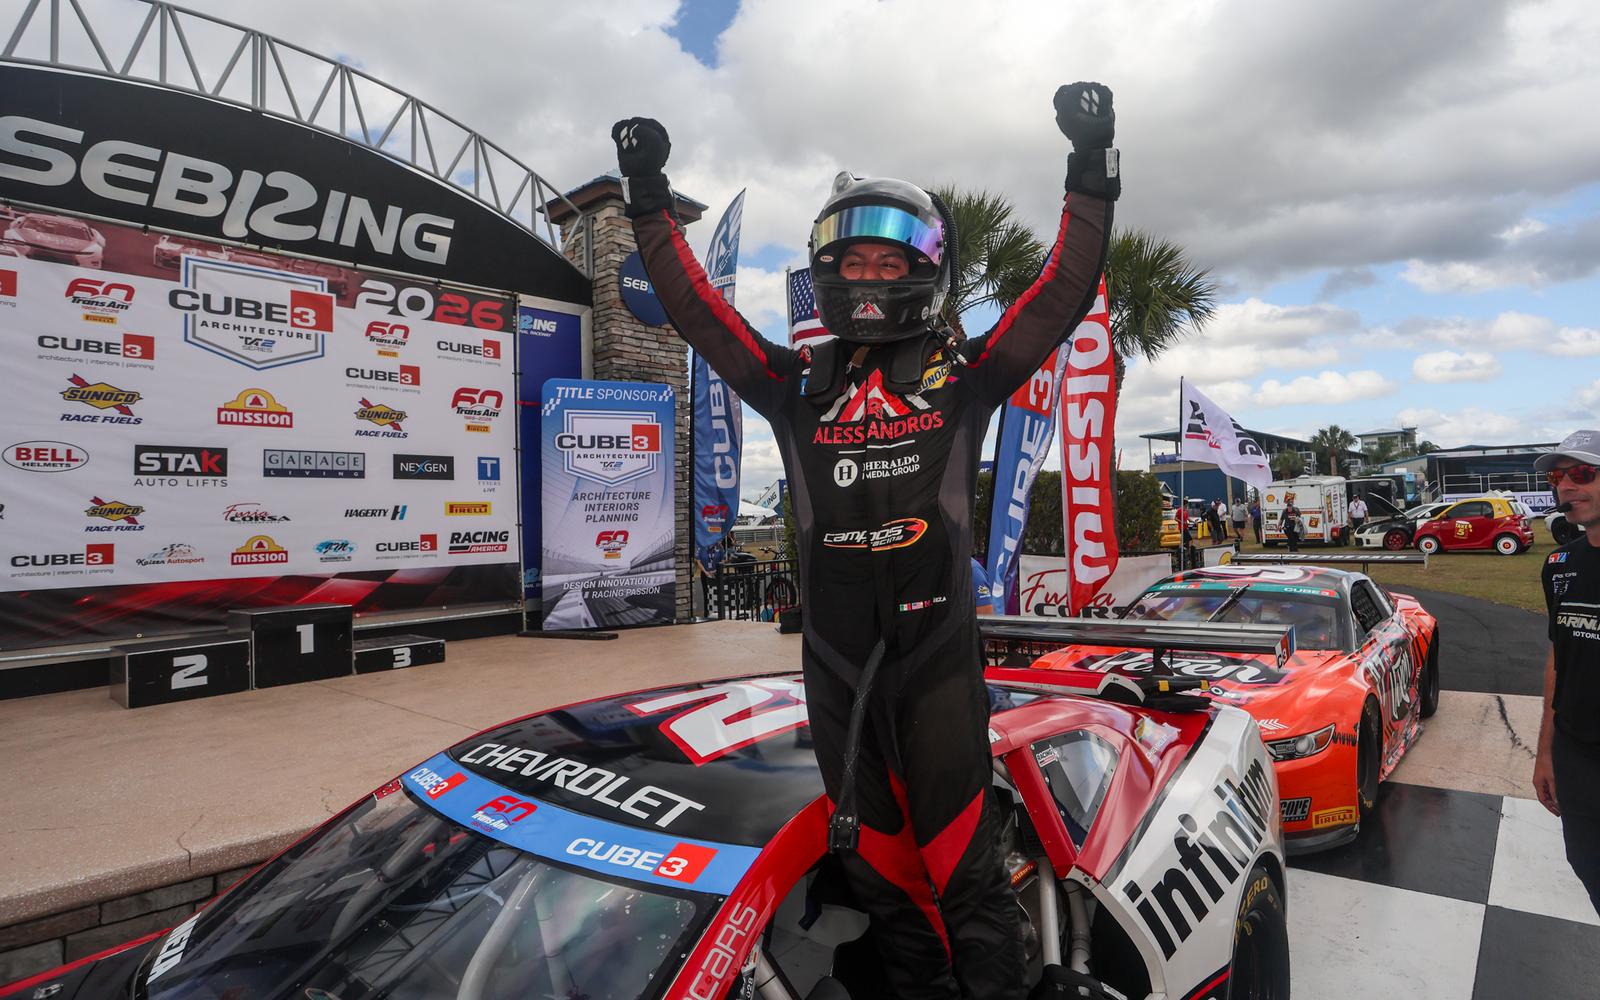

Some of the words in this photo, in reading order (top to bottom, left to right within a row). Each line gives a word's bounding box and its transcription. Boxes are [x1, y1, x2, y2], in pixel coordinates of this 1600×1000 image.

[65, 278, 135, 302] 60
[71, 296, 106, 307] Trans
[106, 301, 129, 311] Am
[168, 288, 316, 327] CUBE3
[355, 279, 504, 331] 2026
[200, 320, 312, 341] ARCHITECTURE
[365, 321, 410, 340] 60
[38, 335, 142, 358] CUBE3
[369, 335, 391, 344] Trans
[392, 338, 406, 346] Am
[437, 340, 494, 356] CUBE3
[346, 367, 412, 384] CUBE3
[67, 389, 139, 403] SUNOCO
[451, 387, 503, 409] 60
[556, 386, 594, 399] TITLE
[597, 389, 658, 402] SPONSOR
[60, 414, 100, 423] RACE
[102, 416, 143, 425] FUELS
[358, 410, 404, 421] SUNOCO
[456, 406, 482, 416] Trans
[483, 409, 499, 418] Am
[382, 431, 408, 439] FUELS
[813, 411, 944, 444] ALESSANDROS
[557, 434, 649, 450] CUBE3
[15, 447, 79, 462] BELL
[268, 454, 360, 467] GARAGE
[862, 454, 920, 471] HERALDO
[400, 461, 447, 473] NEXGEN
[862, 469, 890, 480] MEDIA
[892, 464, 920, 477] GROUP
[134, 478, 178, 487] AUTO
[186, 479, 228, 487] LIFTS
[572, 491, 651, 501] ARCHITECTURE
[91, 507, 140, 516] SUNOCO
[223, 502, 269, 520] Furia
[345, 508, 388, 518] HAGERTY
[449, 503, 488, 514] PIRELLI
[584, 502, 640, 512] INTERIORS
[585, 513, 639, 523] PLANNING
[451, 531, 509, 544] RACING
[376, 541, 431, 552] CUBE3
[11, 553, 103, 567] CUBE3
[563, 580, 596, 590] DESIGN
[597, 577, 650, 588] INNOVATION
[1021, 569, 1116, 613] Fua
[591, 589, 624, 599] RACING
[626, 586, 660, 597] PASSION
[297, 624, 314, 654] 1
[393, 647, 411, 668] 3
[171, 654, 208, 690] 2
[410, 767, 449, 796] CUBE3
[459, 743, 706, 828] CHEVROLET
[471, 810, 491, 825] Trans
[491, 817, 508, 831] Am
[1315, 808, 1353, 826] PIRELLI
[566, 837, 689, 877] CUBE3
[1122, 758, 1273, 962] infinitum
